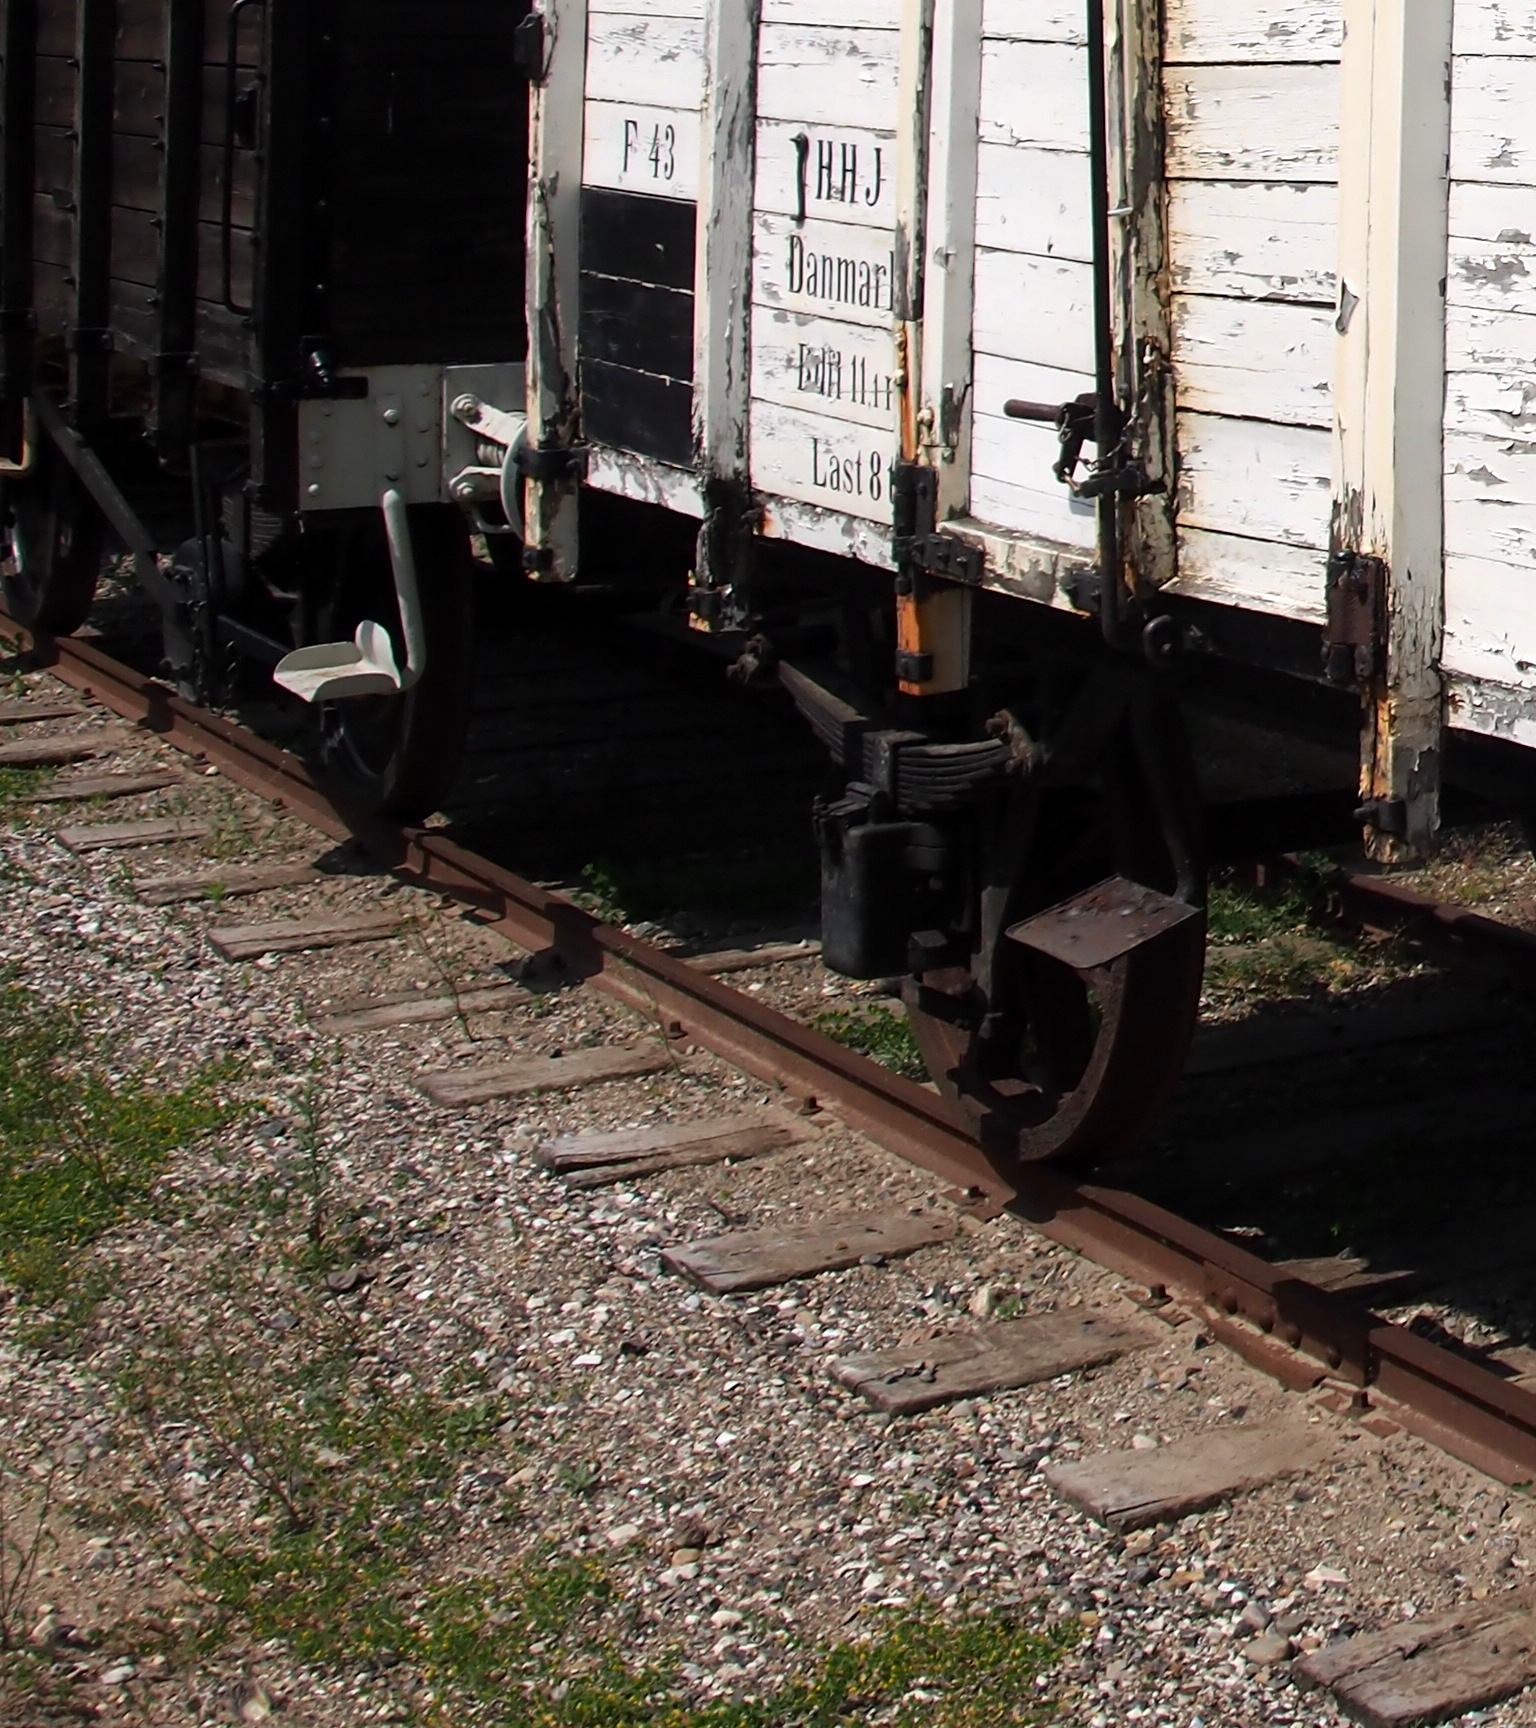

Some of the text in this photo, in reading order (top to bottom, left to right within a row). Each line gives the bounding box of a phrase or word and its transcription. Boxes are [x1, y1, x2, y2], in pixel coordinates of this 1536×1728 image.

[622, 119, 675, 180] F 43
[814, 139, 882, 207] HHJ
[812, 437, 863, 496] Last
[869, 450, 882, 502] 8
